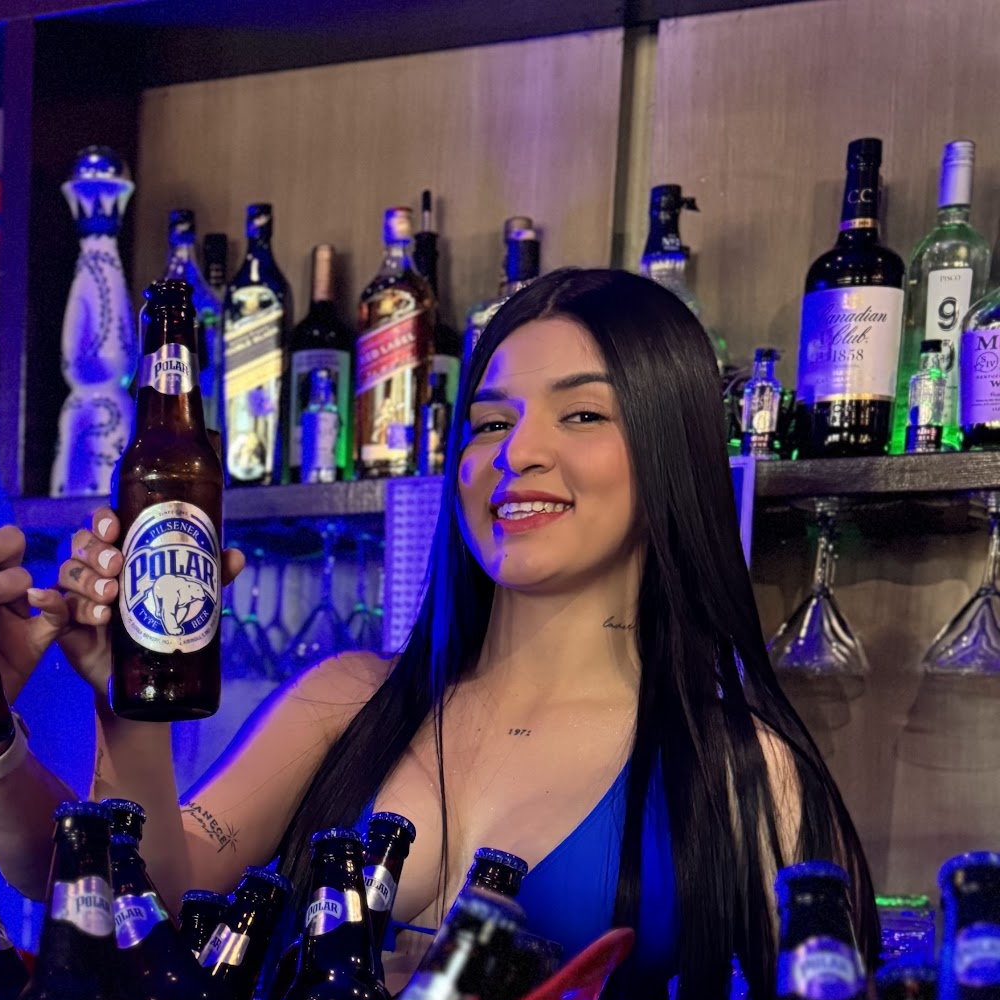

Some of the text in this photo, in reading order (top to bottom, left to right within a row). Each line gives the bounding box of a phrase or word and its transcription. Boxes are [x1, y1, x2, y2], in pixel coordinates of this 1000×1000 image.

[940, 275, 961, 283] PISCO
[937, 296, 960, 332] 9
[832, 348, 864, 362] 1858
[154, 360, 189, 379] POLAR
[150, 520, 200, 540] PILSENER
[128, 549, 215, 601] POLAR
[138, 608, 160, 629] TYPE
[191, 609, 210, 629] BEER
[364, 876, 389, 899] OLAR
[115, 907, 145, 927] OLAR
[307, 902, 338, 921] POLAR
